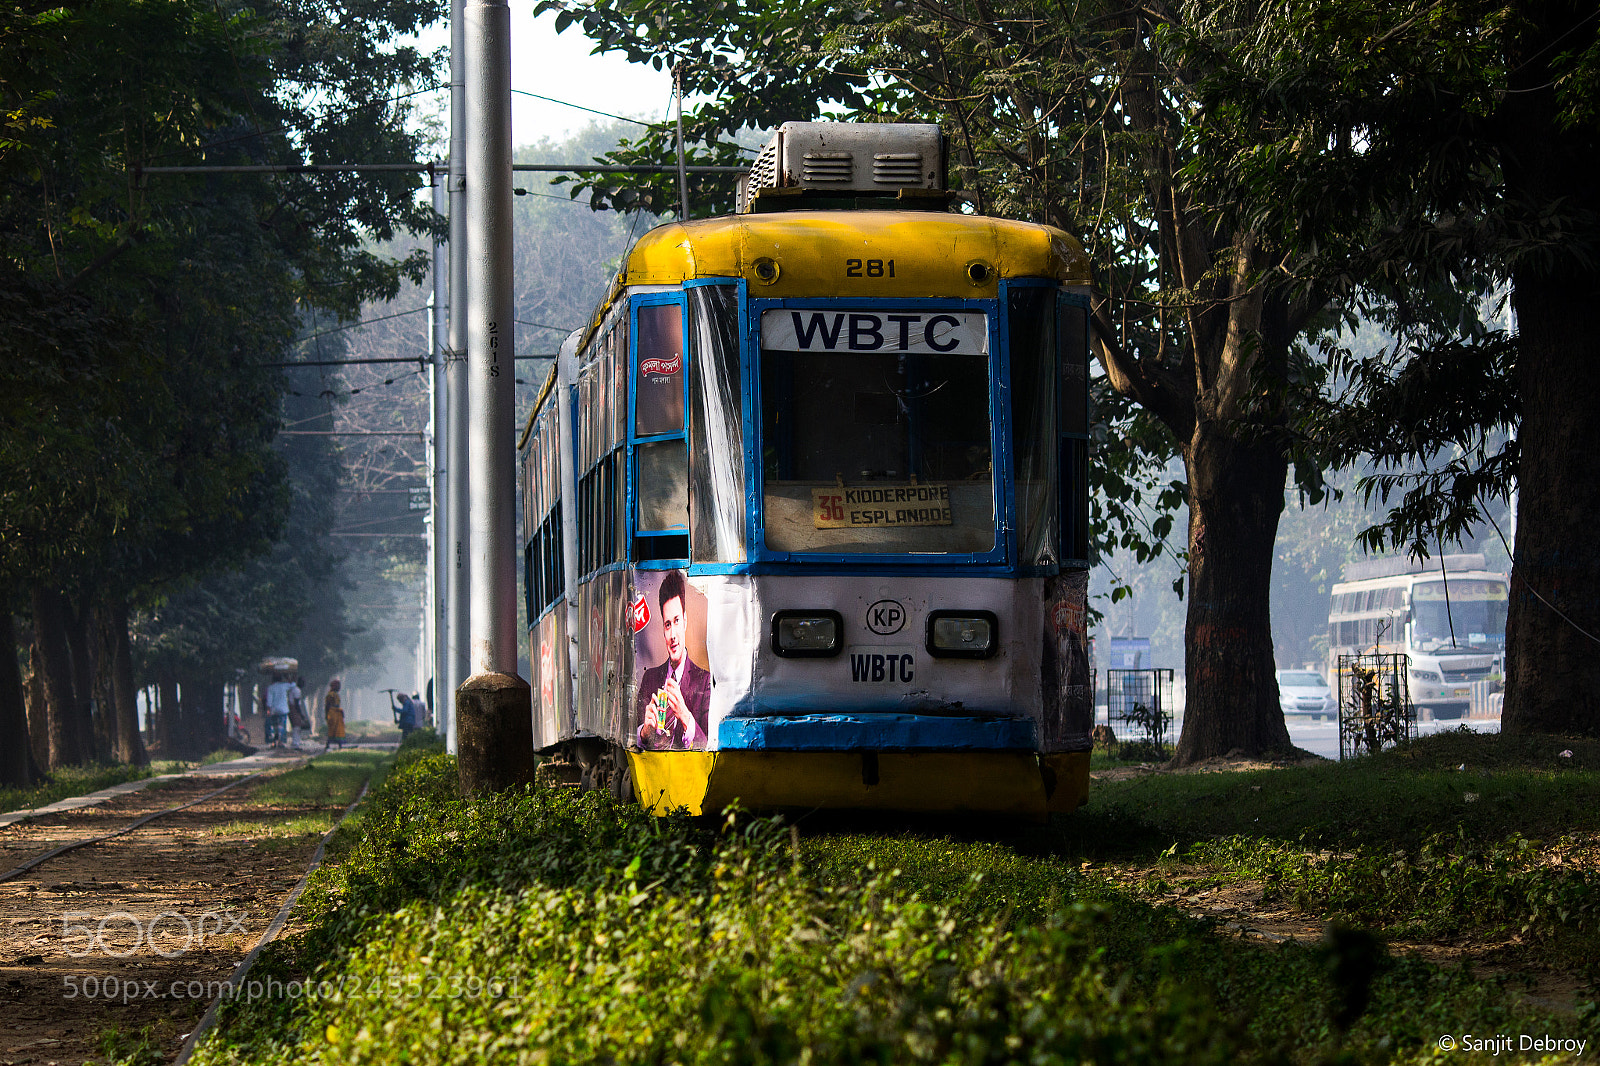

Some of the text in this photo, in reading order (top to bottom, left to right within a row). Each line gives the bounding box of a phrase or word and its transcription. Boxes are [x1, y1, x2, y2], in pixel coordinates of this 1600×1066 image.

[845, 258, 896, 278] 281
[790, 311, 961, 353] WBTC
[845, 486, 949, 504] KIDDERPORE
[818, 495, 845, 521] 36
[850, 507, 952, 525] ESPLANADE
[874, 608, 901, 627] KP
[850, 653, 914, 683] WBTC
